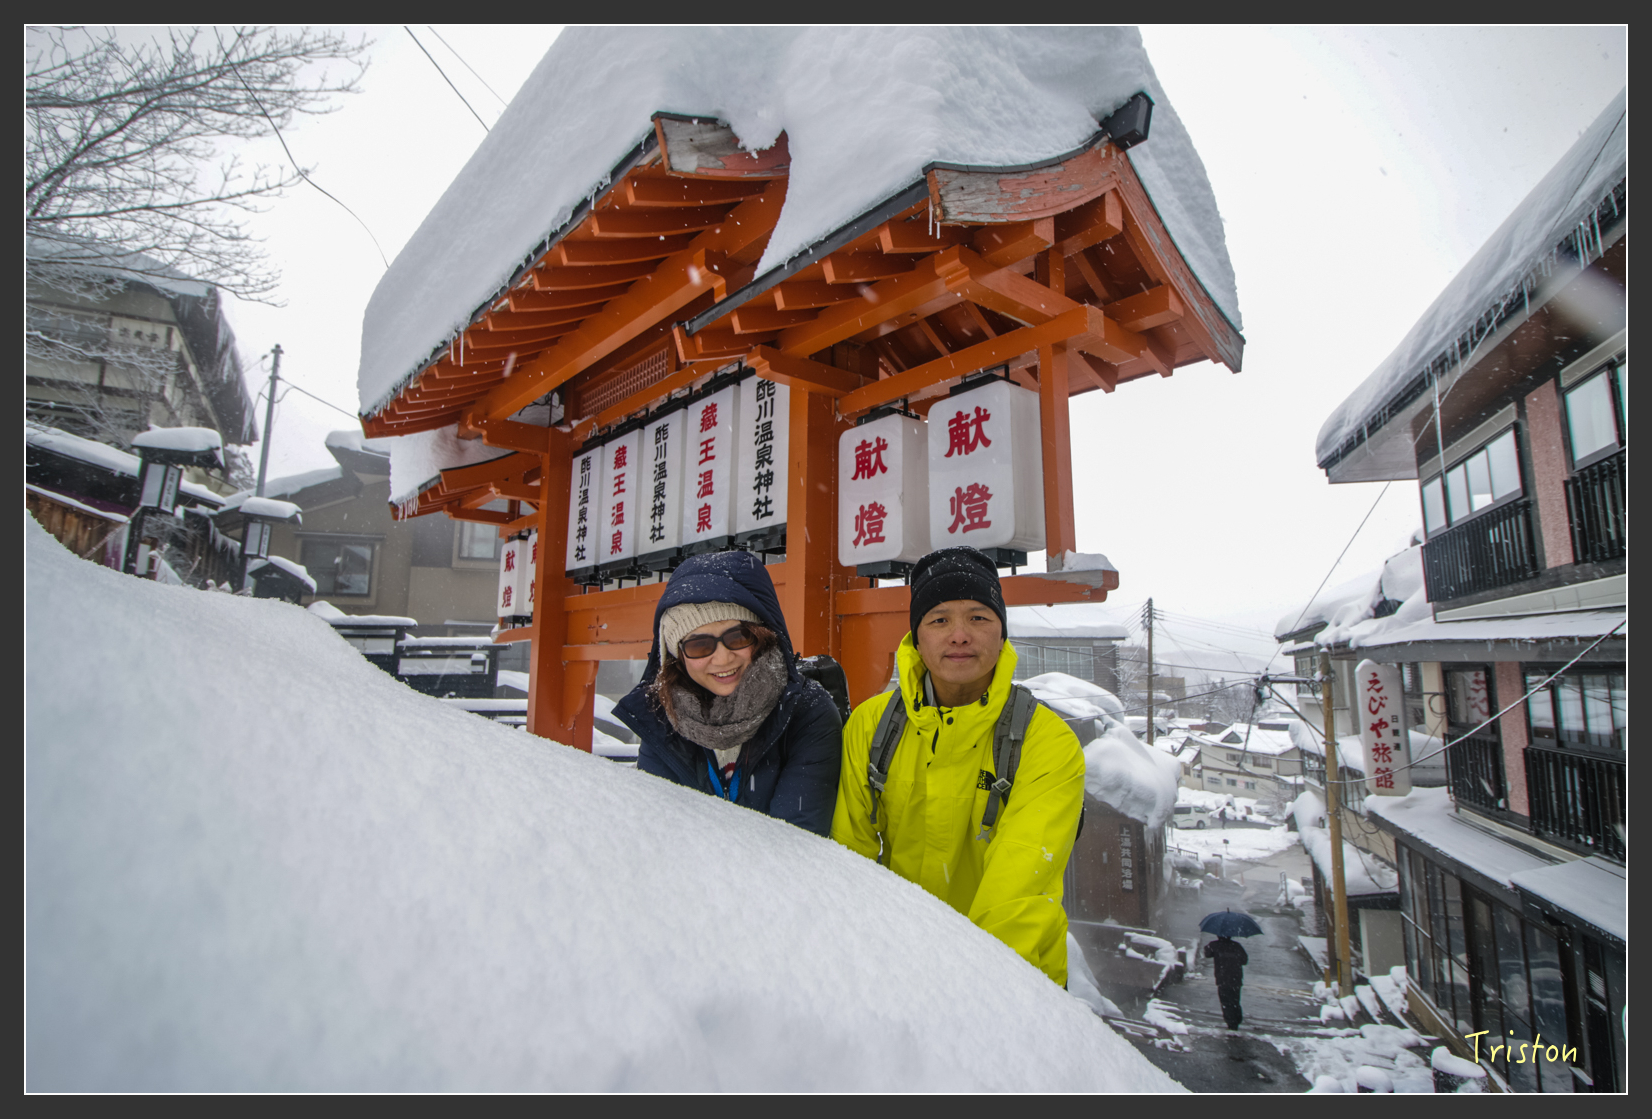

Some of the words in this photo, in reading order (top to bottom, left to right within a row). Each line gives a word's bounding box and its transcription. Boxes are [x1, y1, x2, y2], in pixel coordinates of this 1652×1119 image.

[650, 423, 669, 543] 酢川温泉神社
[752, 378, 776, 520] 酢川温泉神社
[851, 436, 888, 547] 献燈
[944, 406, 993, 534] 献燈
[575, 456, 591, 561] 酢川温泉神社
[1367, 672, 1395, 789] えびや旅館
